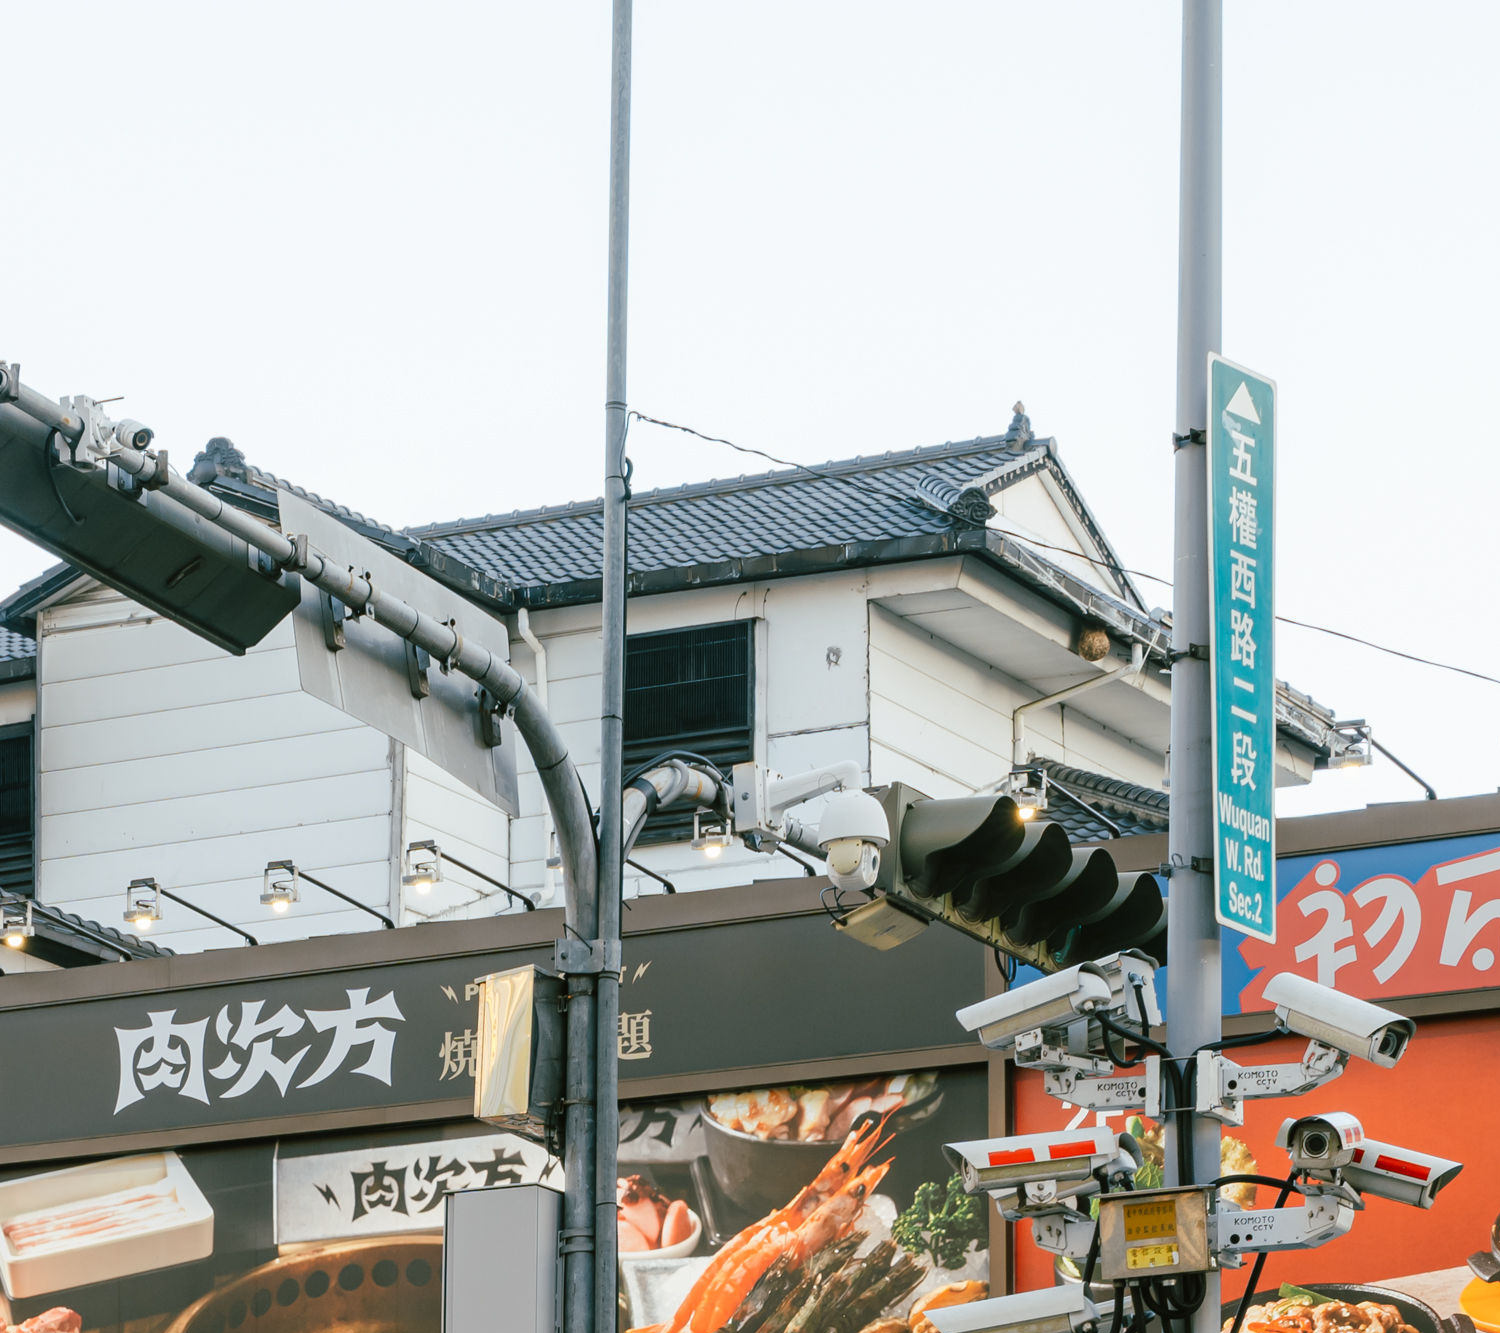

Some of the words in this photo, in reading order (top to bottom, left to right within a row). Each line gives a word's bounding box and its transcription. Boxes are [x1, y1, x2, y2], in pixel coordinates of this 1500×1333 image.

[1227, 433, 1259, 794] 五權西路二段
[1218, 789, 1271, 844] Wuquan
[1228, 879, 1264, 926] Sec.2
[112, 985, 408, 1118] 肉次方
[1237, 1069, 1279, 1081] KOMOTO
[1096, 1081, 1139, 1094] KOMOTO
[1256, 1076, 1278, 1087] CCTV
[1115, 1088, 1138, 1098] CCTV
[1233, 1215, 1276, 1227] KOMOTO
[1252, 1222, 1275, 1232] CCTV
